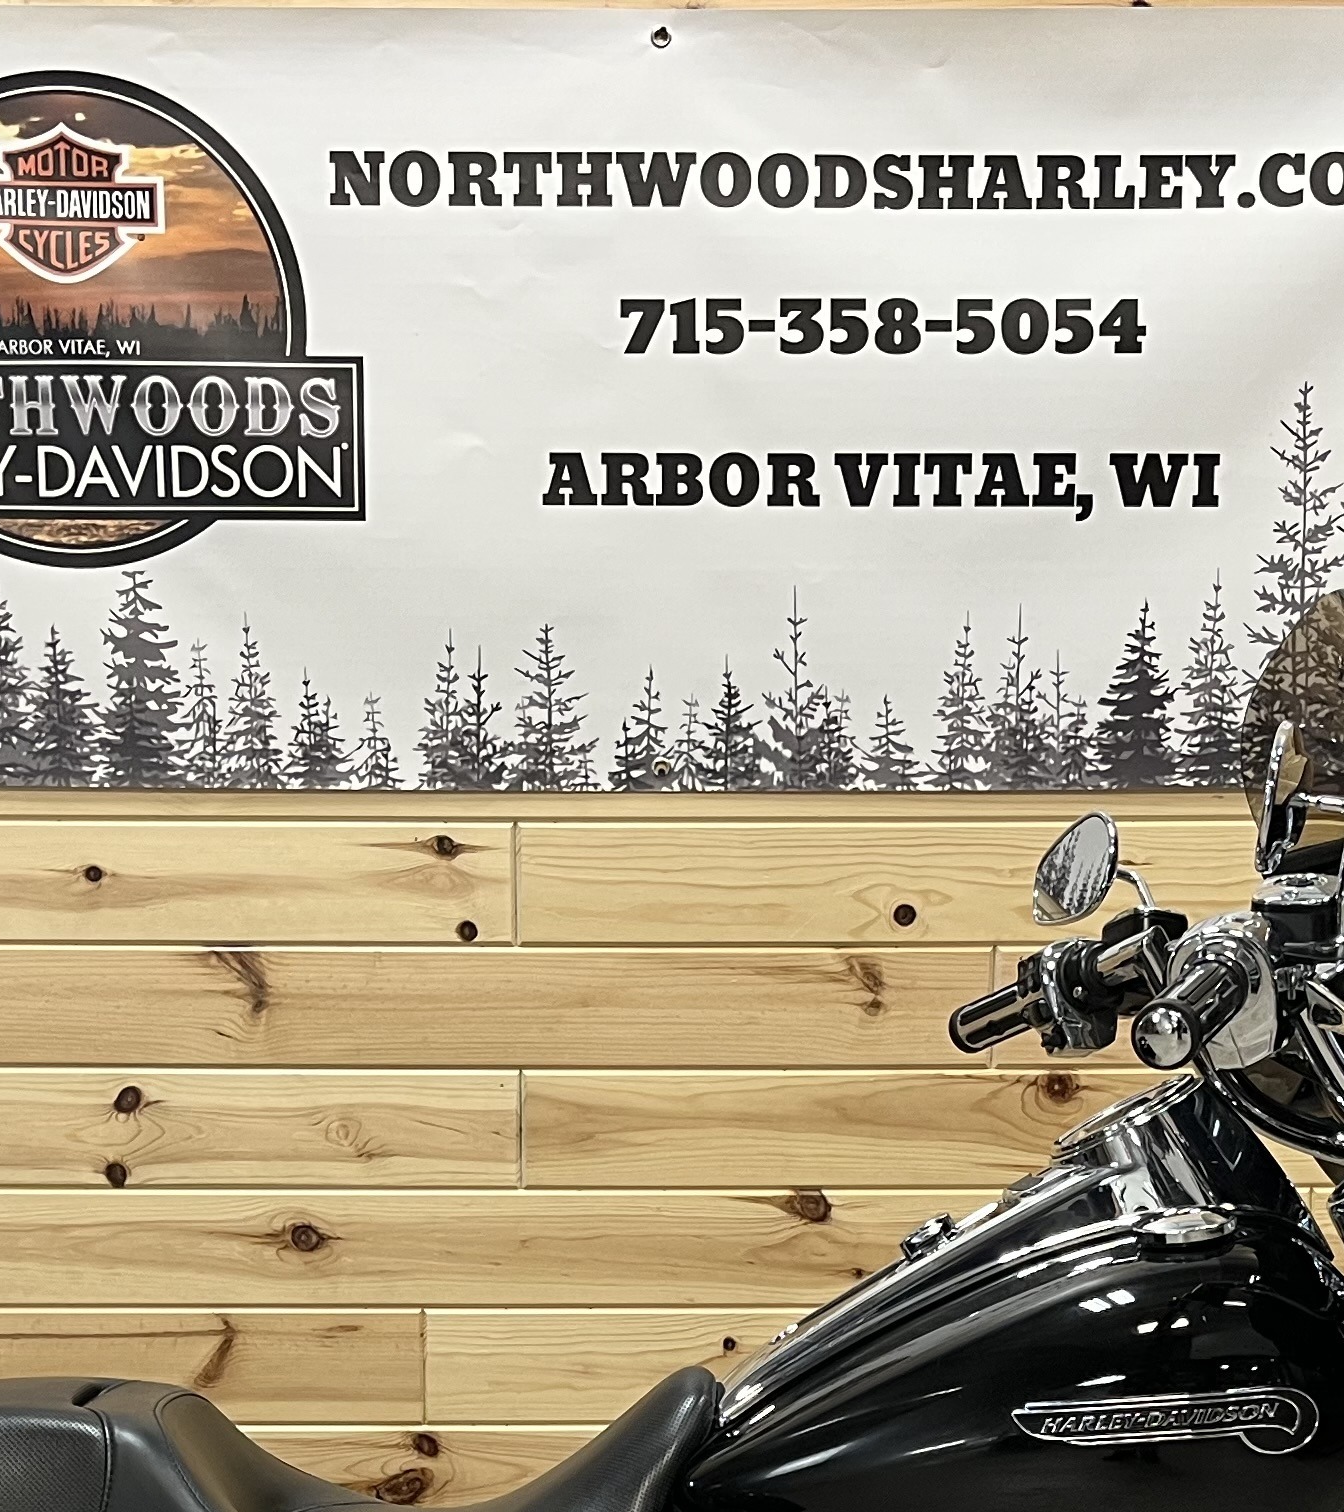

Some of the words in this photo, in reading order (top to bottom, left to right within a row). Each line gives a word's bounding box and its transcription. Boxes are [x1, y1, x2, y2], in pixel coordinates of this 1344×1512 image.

[17, 141, 109, 178] MOTOR
[18, 229, 110, 270] CYCLES
[620, 297, 1148, 357] 715-358-5054
[58, 339, 111, 359] VITAE,
[116, 340, 141, 357] WI
[542, 451, 822, 509] ARBOR
[834, 452, 1095, 523] VITAE,
[1109, 452, 1223, 509] WI
[1040, 1402, 1280, 1435] HARLEY-DAVIDSON
